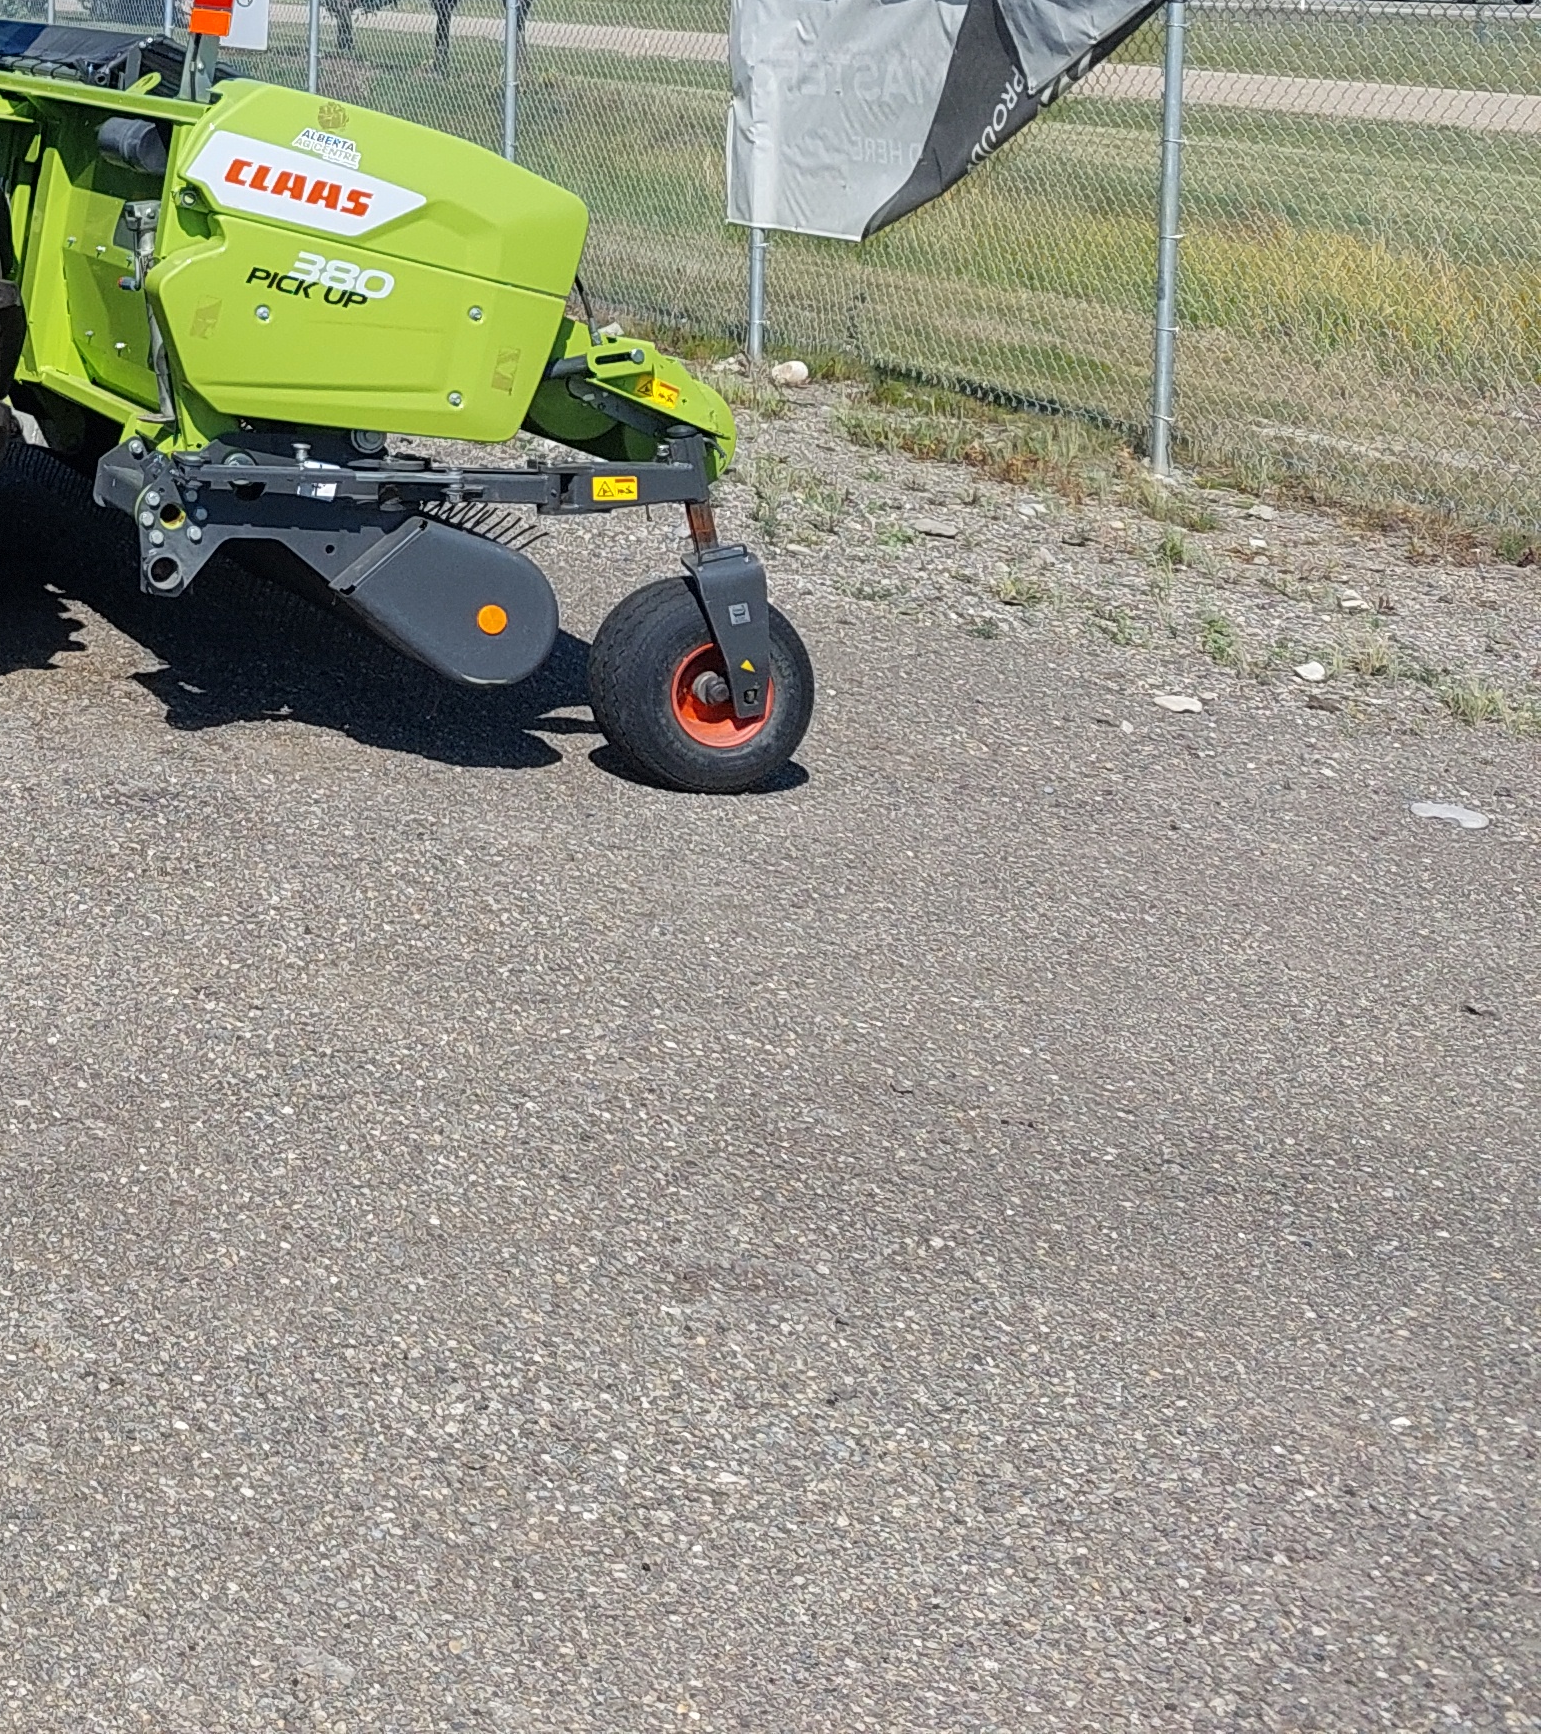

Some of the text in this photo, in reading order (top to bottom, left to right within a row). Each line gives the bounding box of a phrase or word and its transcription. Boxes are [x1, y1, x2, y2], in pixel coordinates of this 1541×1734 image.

[301, 129, 354, 152] ALBERTA
[313, 142, 359, 163] CENTRE
[224, 158, 374, 217] CLAAS
[245, 266, 369, 309] PICK UP
[287, 250, 396, 300] 380
